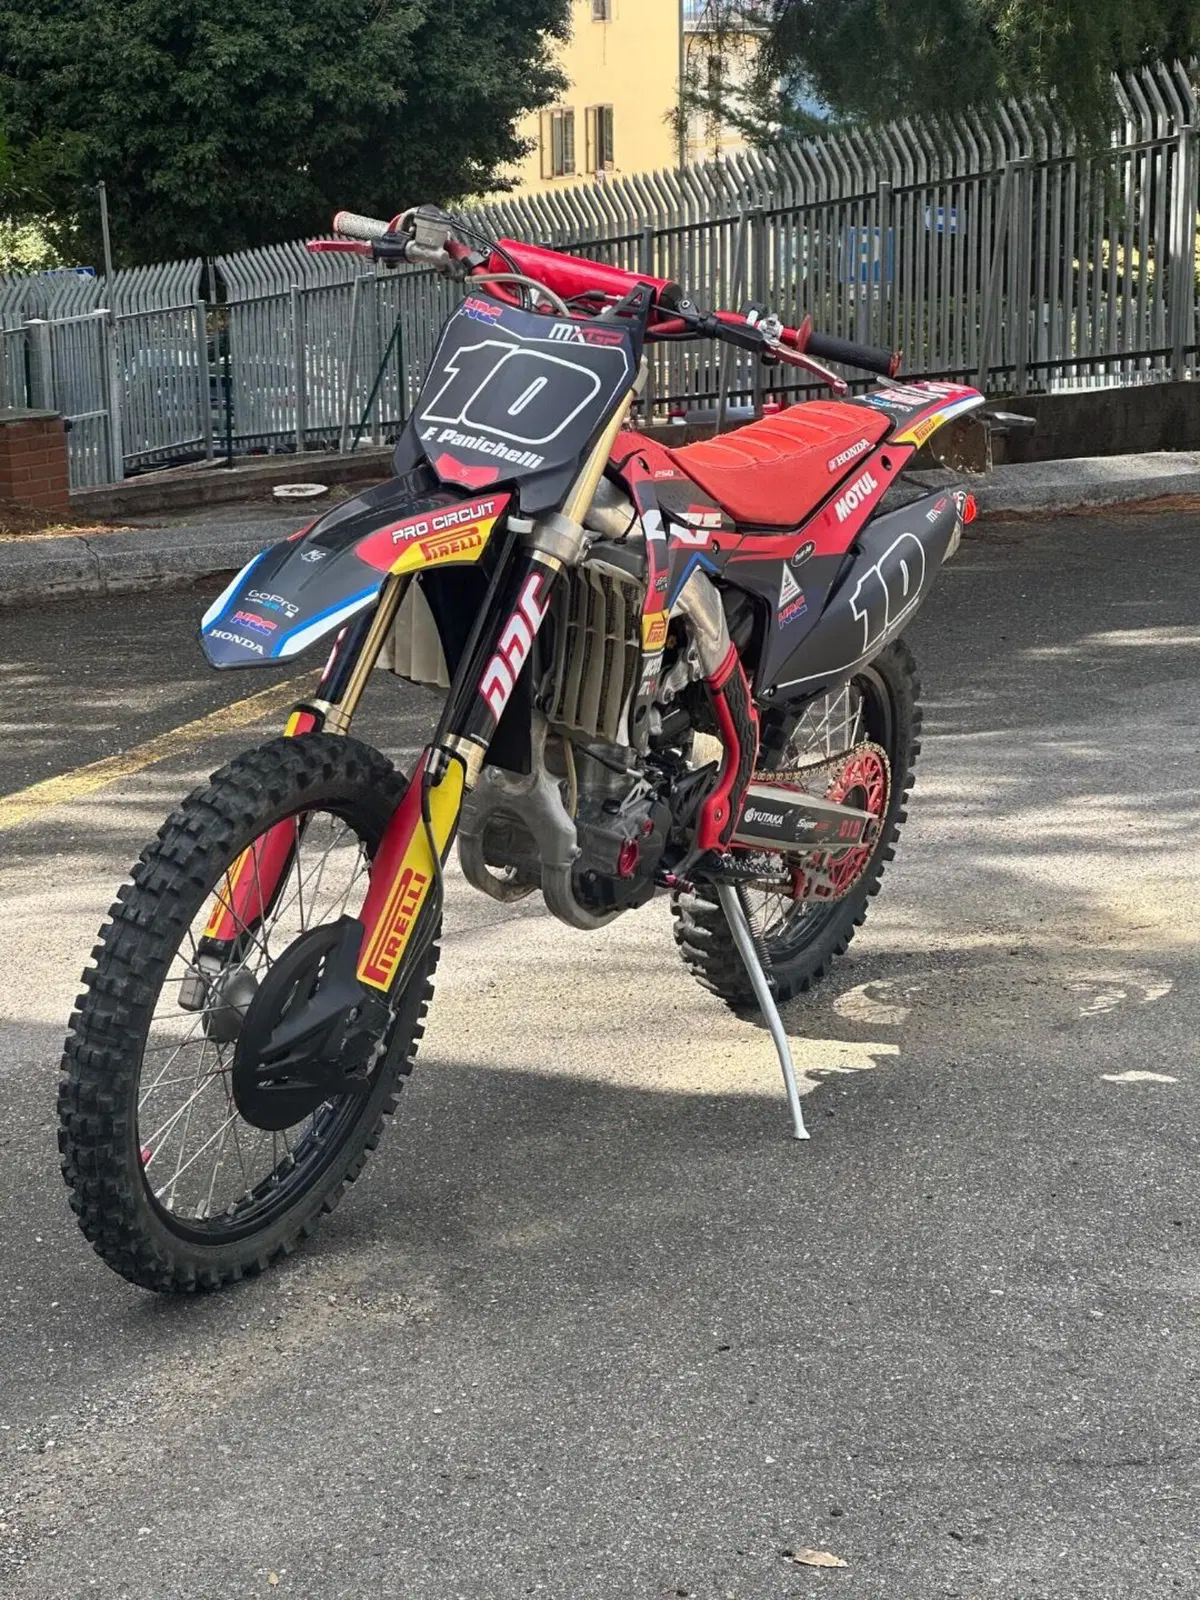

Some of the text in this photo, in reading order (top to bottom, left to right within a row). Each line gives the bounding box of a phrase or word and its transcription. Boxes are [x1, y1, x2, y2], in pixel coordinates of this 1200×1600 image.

[548, 323, 624, 344] MXGP
[420, 339, 601, 445] 10
[420, 427, 546, 469] F. Panichelli
[835, 438, 871, 466] HONDA
[834, 471, 878, 523] MOTUL
[392, 501, 495, 545] PRO CIRCUIT
[419, 526, 483, 562] PIRELLI
[248, 589, 300, 614] GoPro
[849, 532, 926, 654] 10
[209, 628, 266, 655] HONDA
[230, 610, 278, 637] HRC
[752, 810, 784, 825] YUTAKA
[362, 867, 428, 985] PIRELLI
